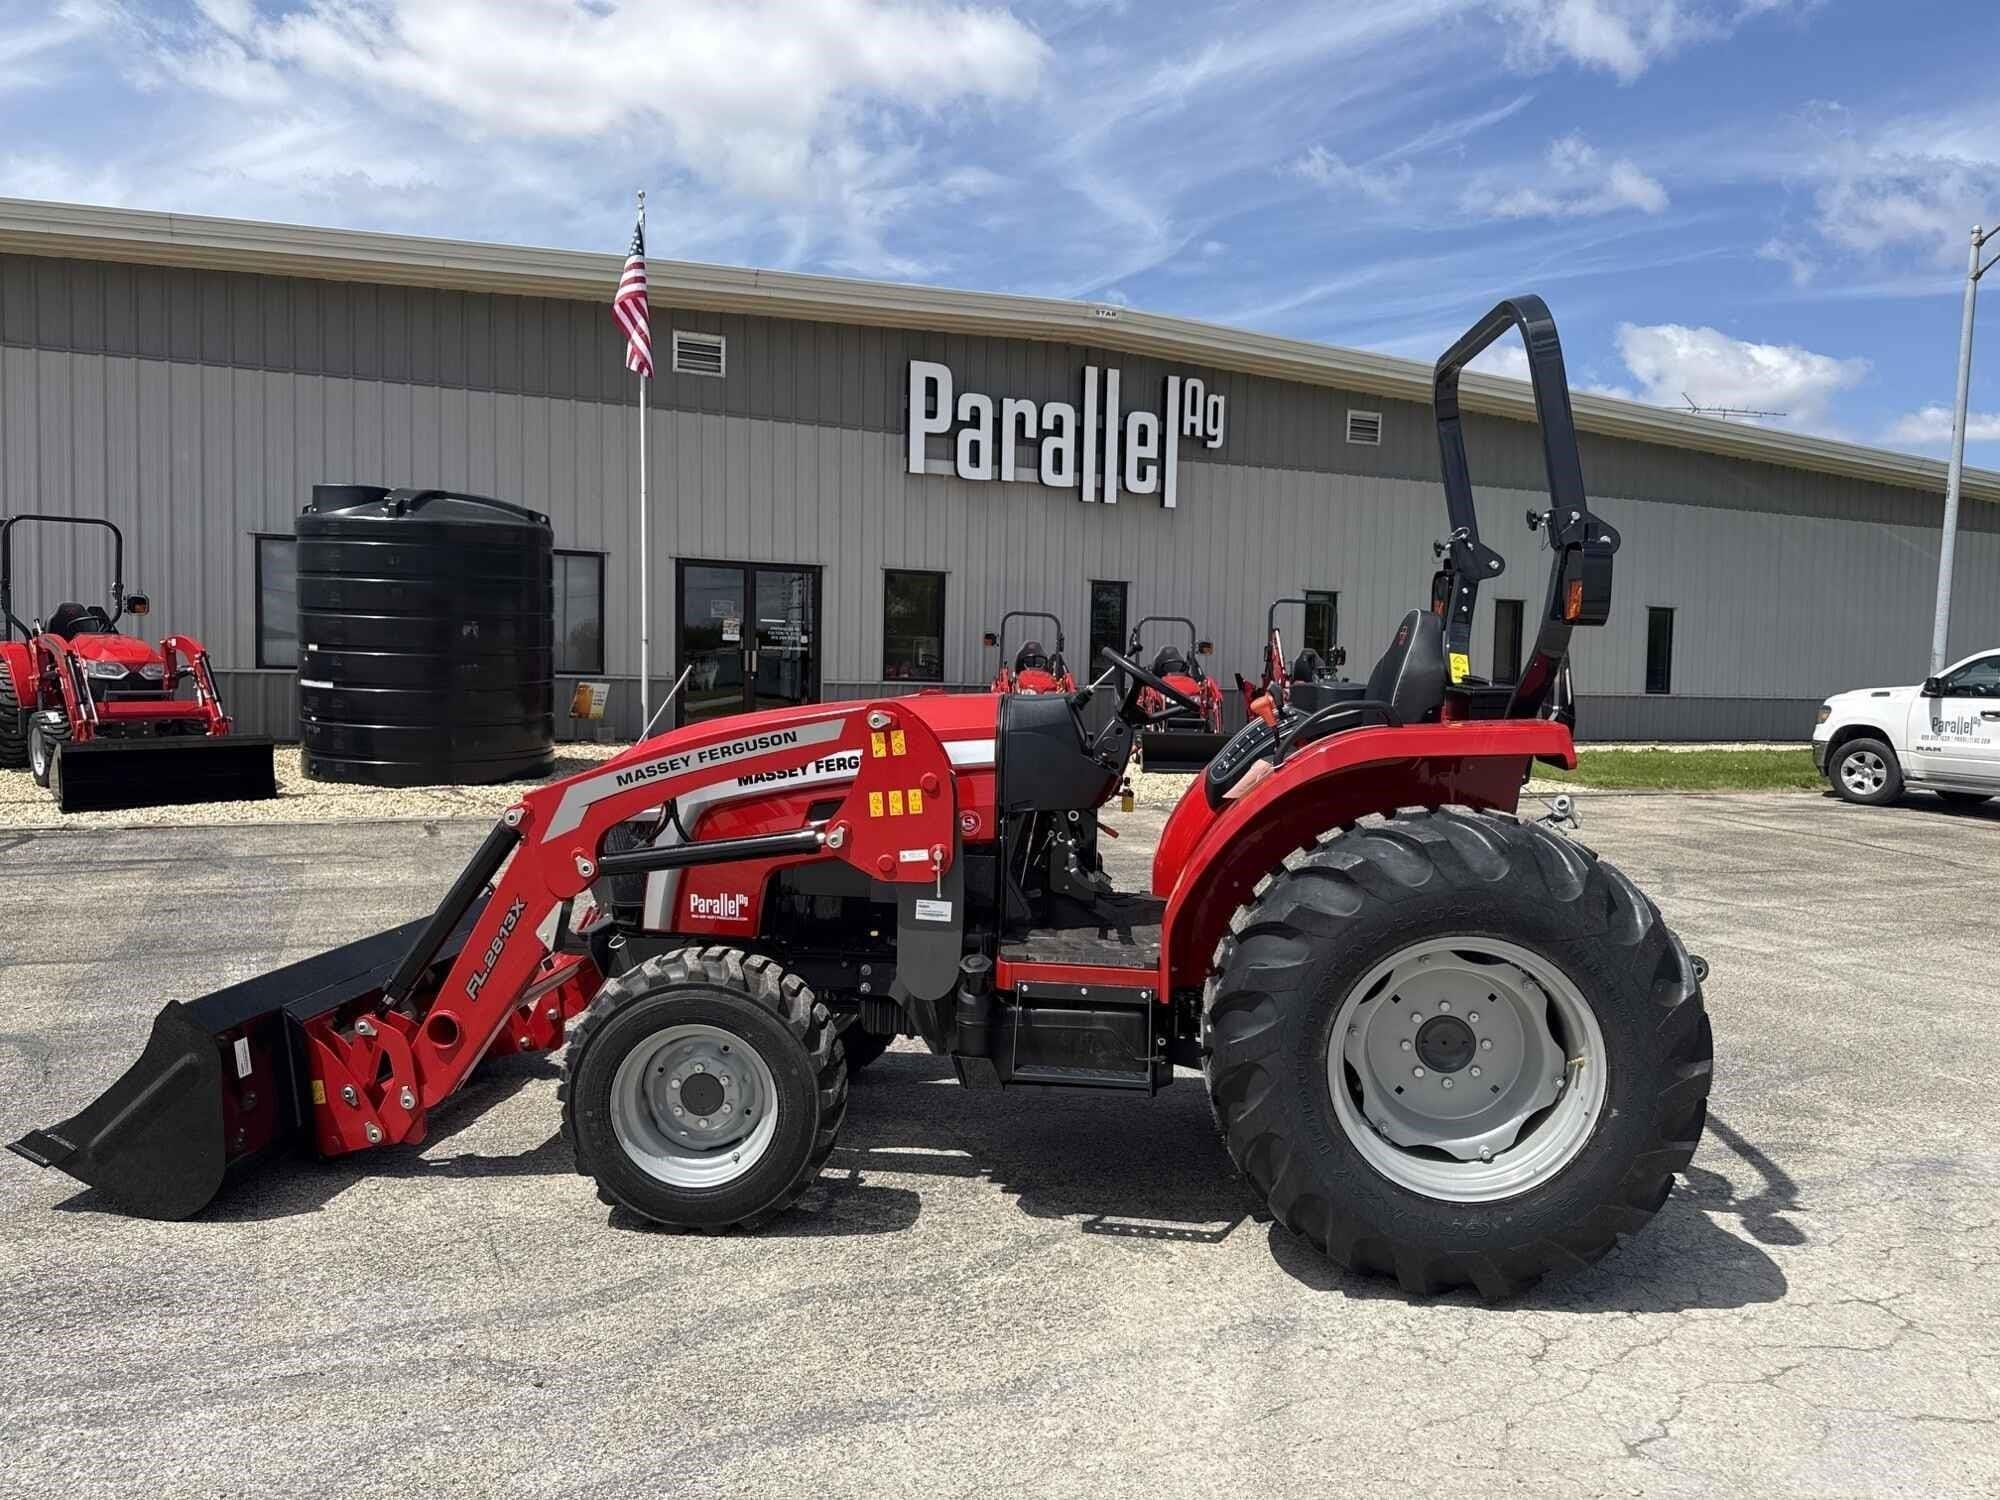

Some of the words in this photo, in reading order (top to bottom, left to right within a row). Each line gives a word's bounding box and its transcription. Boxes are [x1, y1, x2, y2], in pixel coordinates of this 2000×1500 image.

[908, 359, 1180, 508] Parallel
[1183, 377, 1226, 448] Ag
[1931, 716, 1973, 736] Parallel
[616, 755, 691, 787] MASSEY
[697, 731, 797, 763] FERGUSON
[737, 763, 809, 787] MASSEY
[814, 756, 860, 775] FERG
[690, 892, 739, 917] Parallel
[465, 894, 528, 1001] FL.2813X
